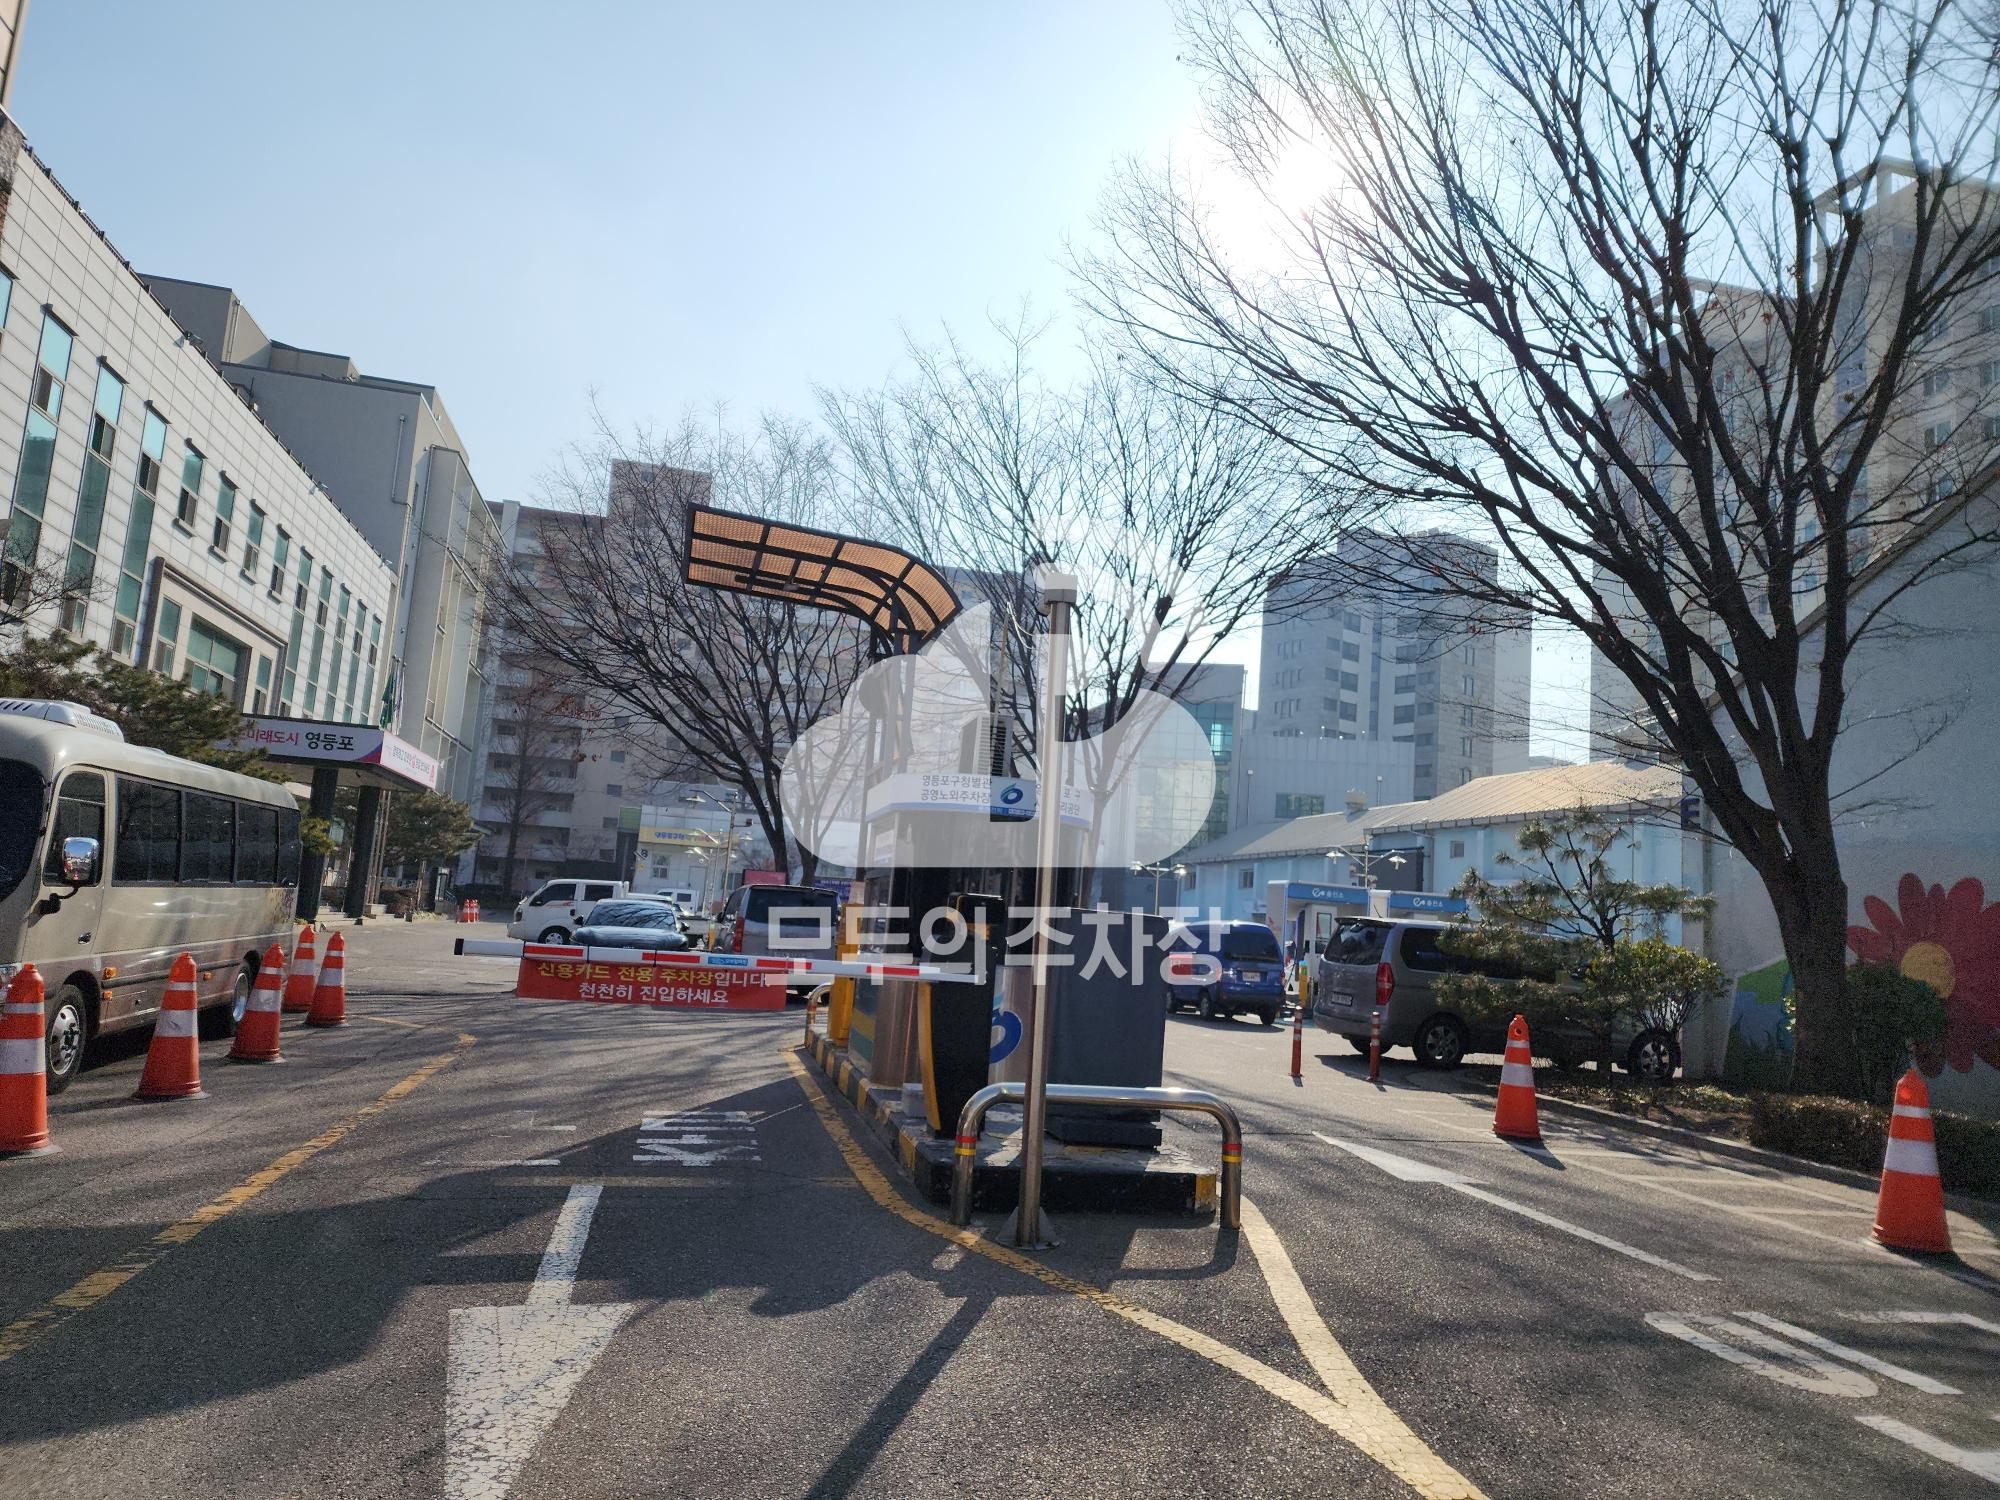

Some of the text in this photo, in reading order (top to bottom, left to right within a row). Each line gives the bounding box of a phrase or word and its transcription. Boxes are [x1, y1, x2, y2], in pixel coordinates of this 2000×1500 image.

[304, 731, 355, 752] 영등포
[921, 788, 990, 804] 공영노외주차장
[537, 961, 611, 981] 신용카드
[617, 965, 655, 983] 전용
[578, 982, 728, 1005] 천천히 진입하세요
